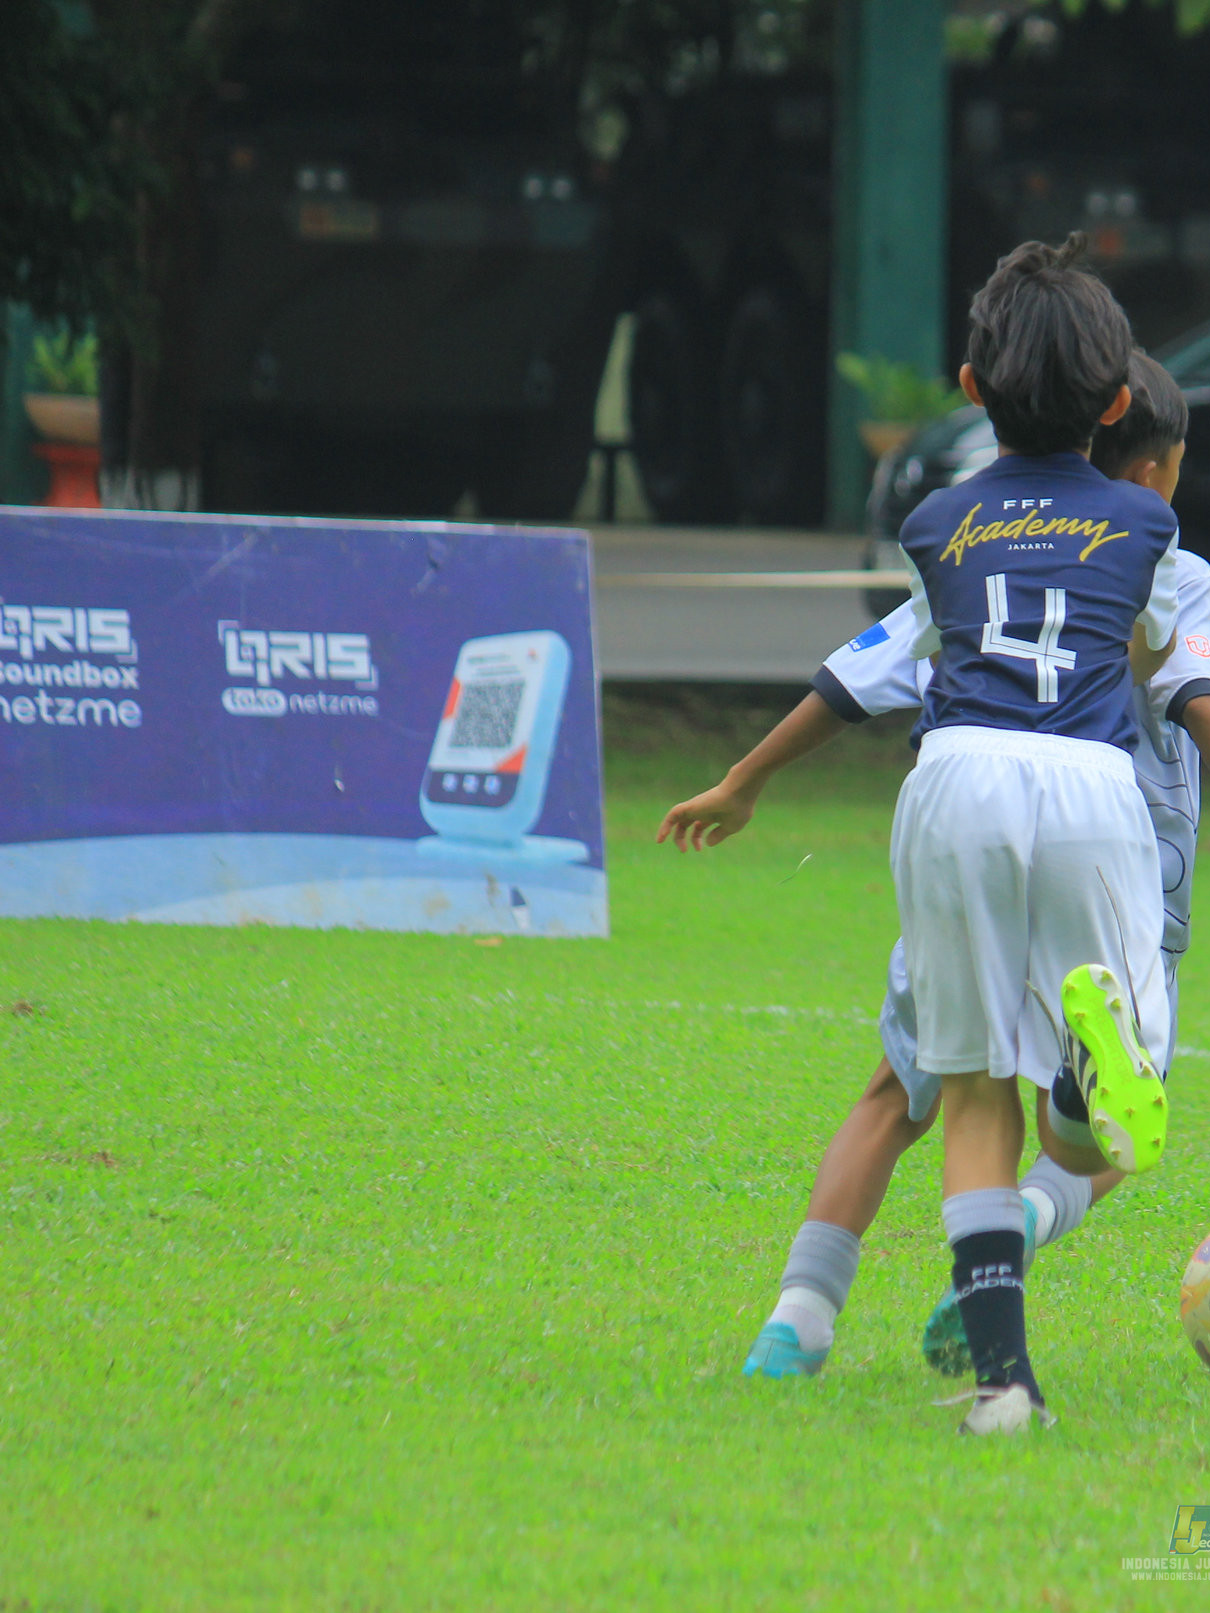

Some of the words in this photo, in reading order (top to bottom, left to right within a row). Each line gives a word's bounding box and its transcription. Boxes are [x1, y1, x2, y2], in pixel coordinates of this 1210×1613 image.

[1003, 498, 1053, 510] FFF
[939, 502, 1129, 566] Academy
[1007, 542, 1055, 551] JAKARTA
[980, 572, 1077, 703] 4
[224, 628, 371, 687] QRIS
[289, 689, 380, 717] netzme
[952, 1276, 1027, 1304] ACADEM
